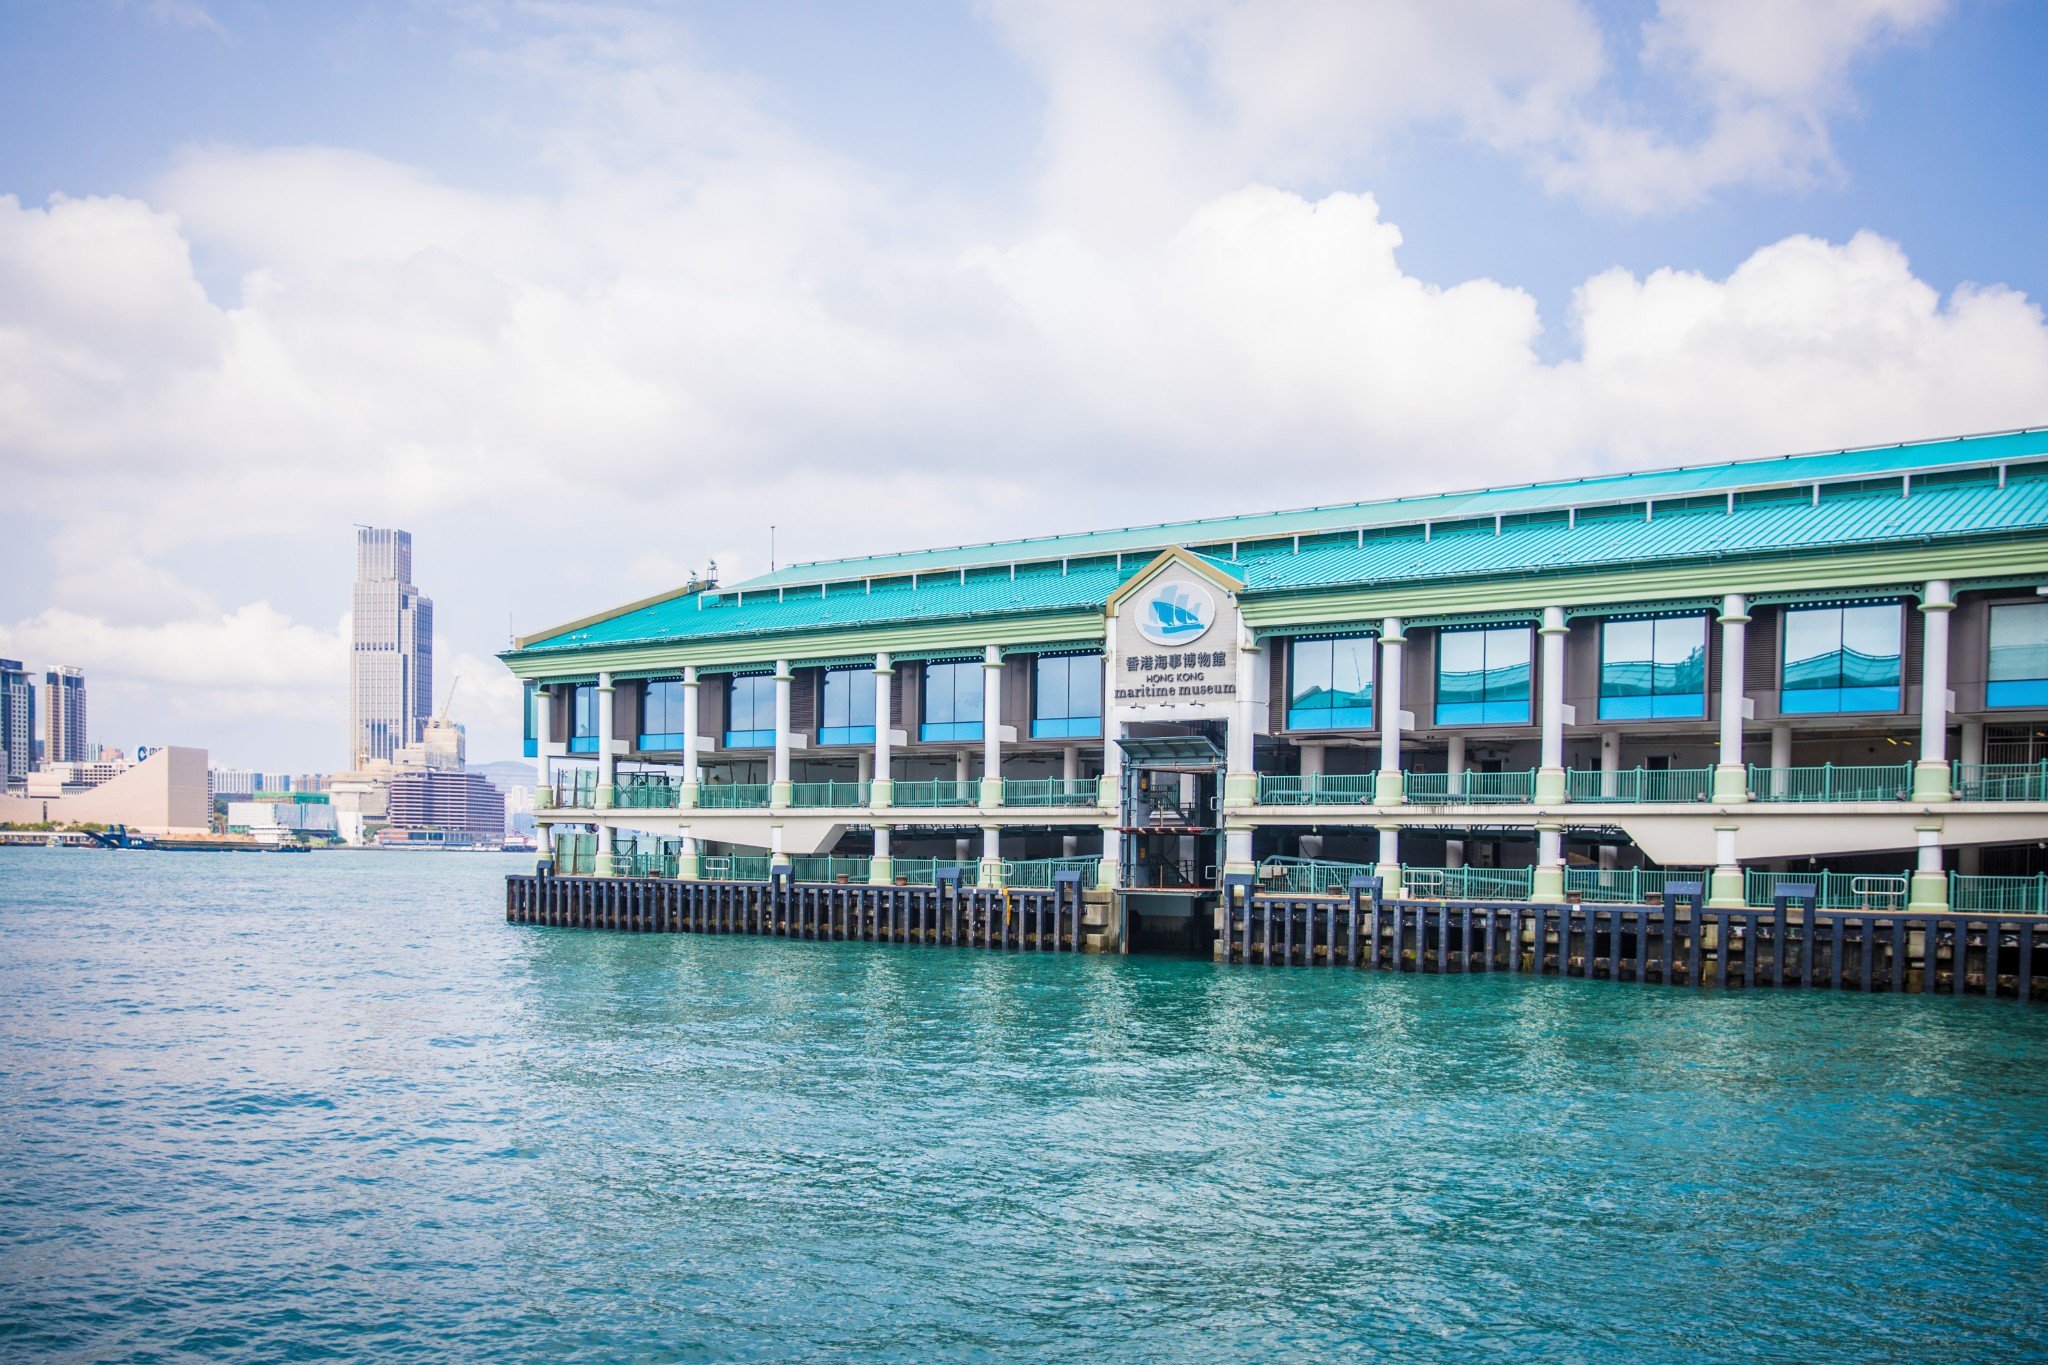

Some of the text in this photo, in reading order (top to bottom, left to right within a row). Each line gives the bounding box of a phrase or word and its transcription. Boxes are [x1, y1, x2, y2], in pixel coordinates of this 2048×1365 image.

[1126, 651, 1226, 672] 香港海事博物館
[1146, 672, 1204, 683] HONG KONG
[1115, 684, 1236, 698] maritime museum
